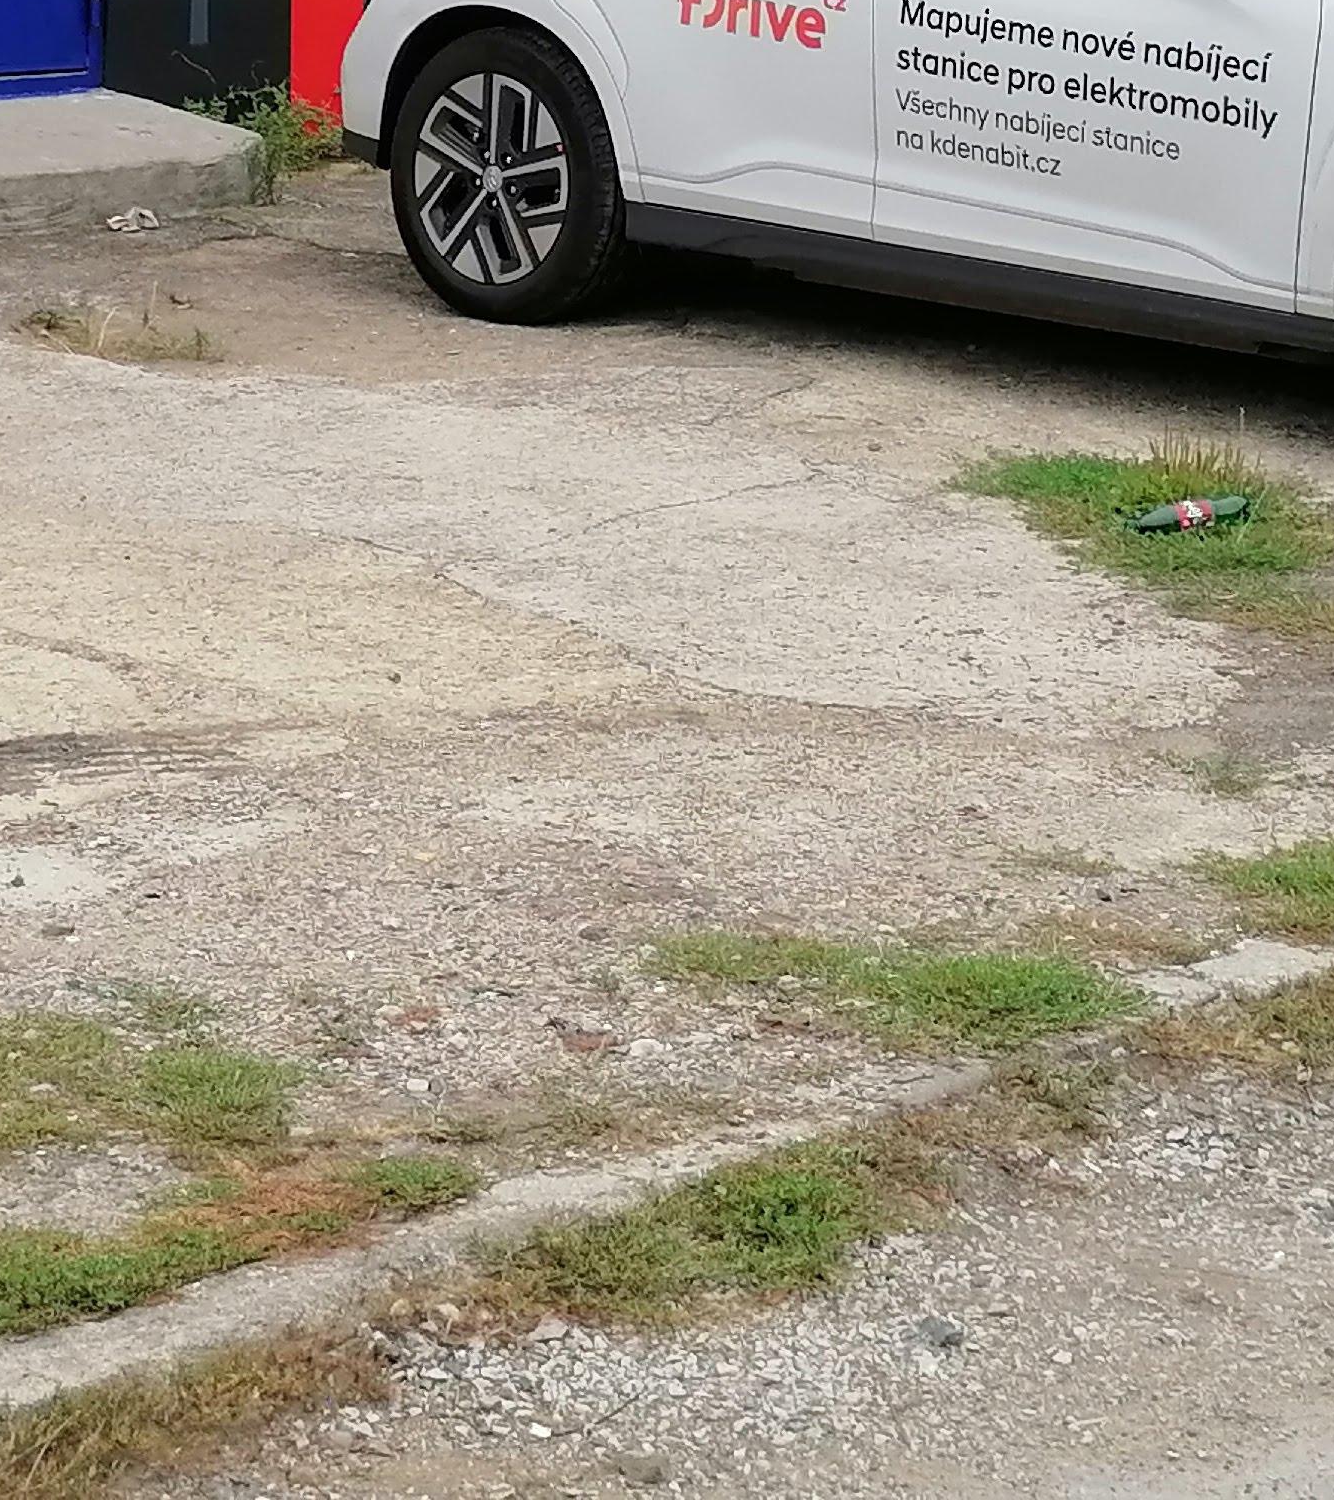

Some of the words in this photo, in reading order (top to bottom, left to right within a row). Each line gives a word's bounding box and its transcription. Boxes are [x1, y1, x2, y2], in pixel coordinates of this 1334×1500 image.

[1062, 28, 1136, 61] nové
[1144, 41, 1272, 83] nabíjecí
[895, 88, 990, 131] Všechny
[1091, 125, 1181, 161] stanice
[896, 46, 1000, 85] stanice
[1007, 67, 1055, 95] pro
[1064, 72, 1278, 140] elektromobily
[896, 129, 924, 150] na
[930, 130, 1062, 177] kdenabit.cz
